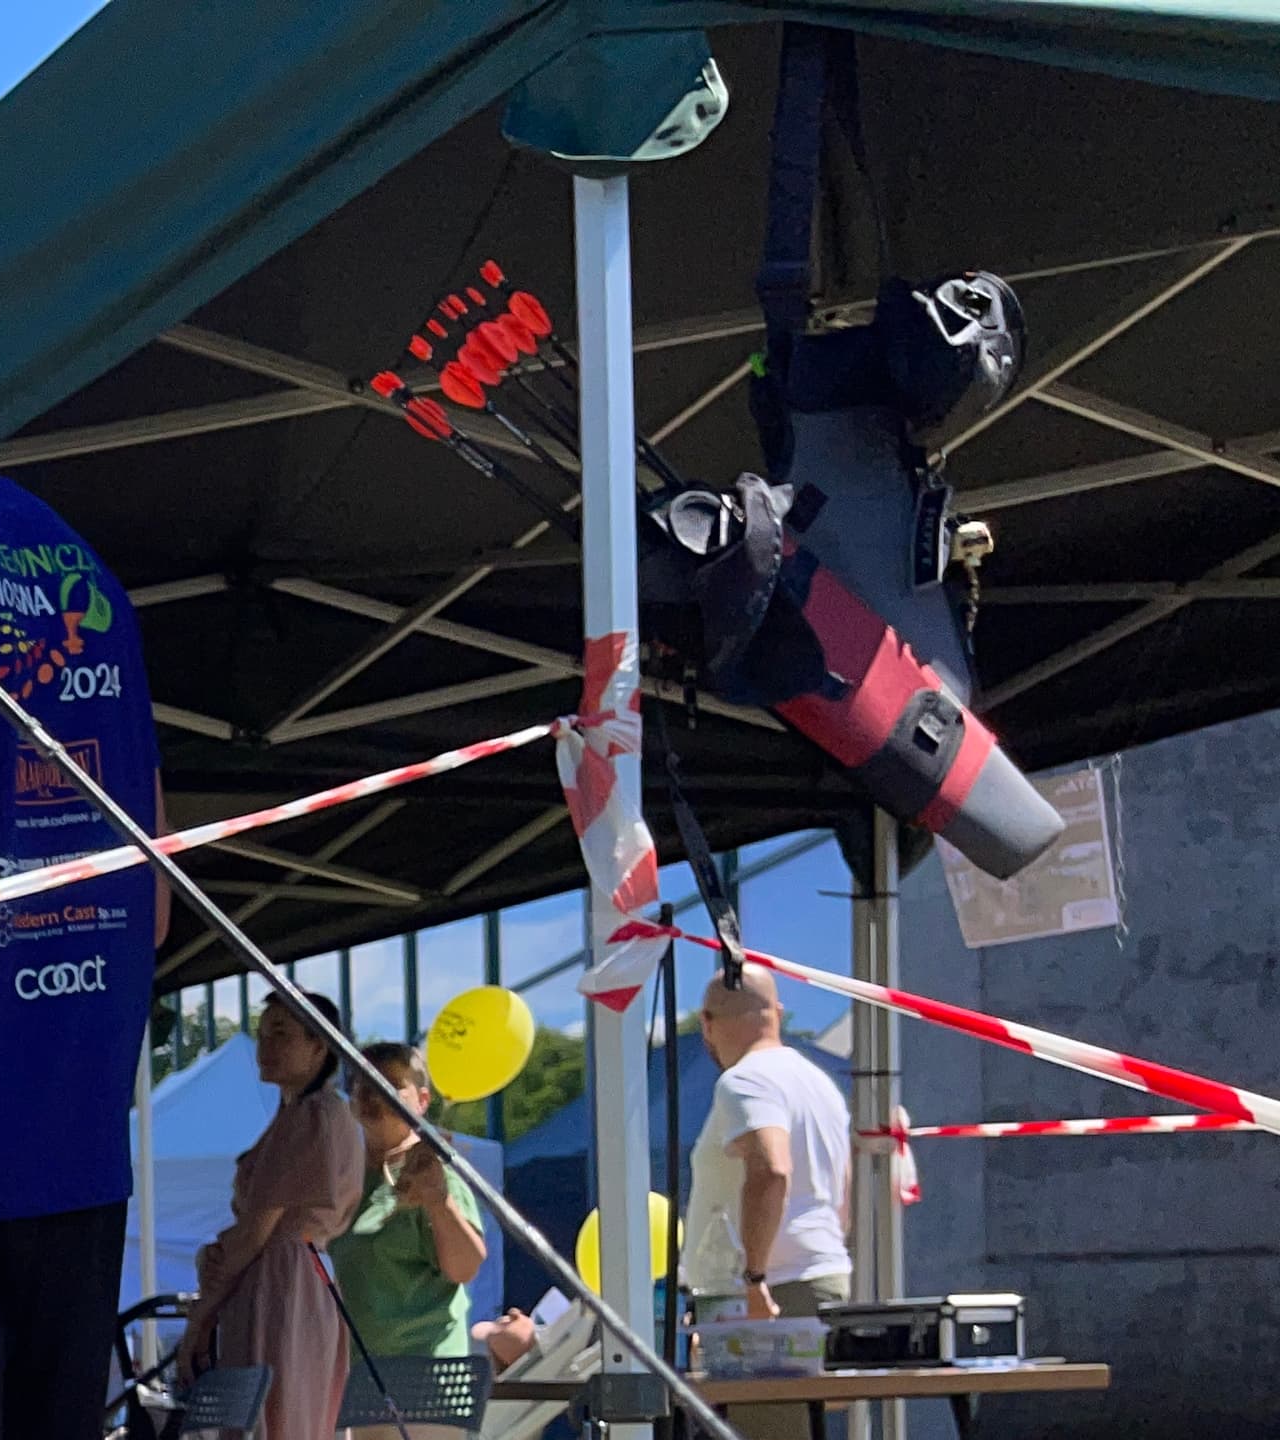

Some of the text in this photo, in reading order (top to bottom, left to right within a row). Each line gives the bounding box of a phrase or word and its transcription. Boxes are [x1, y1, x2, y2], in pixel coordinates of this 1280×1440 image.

[58, 662, 123, 702] 2024
[63, 904, 97, 923] Cast
[14, 954, 108, 1001] coact
